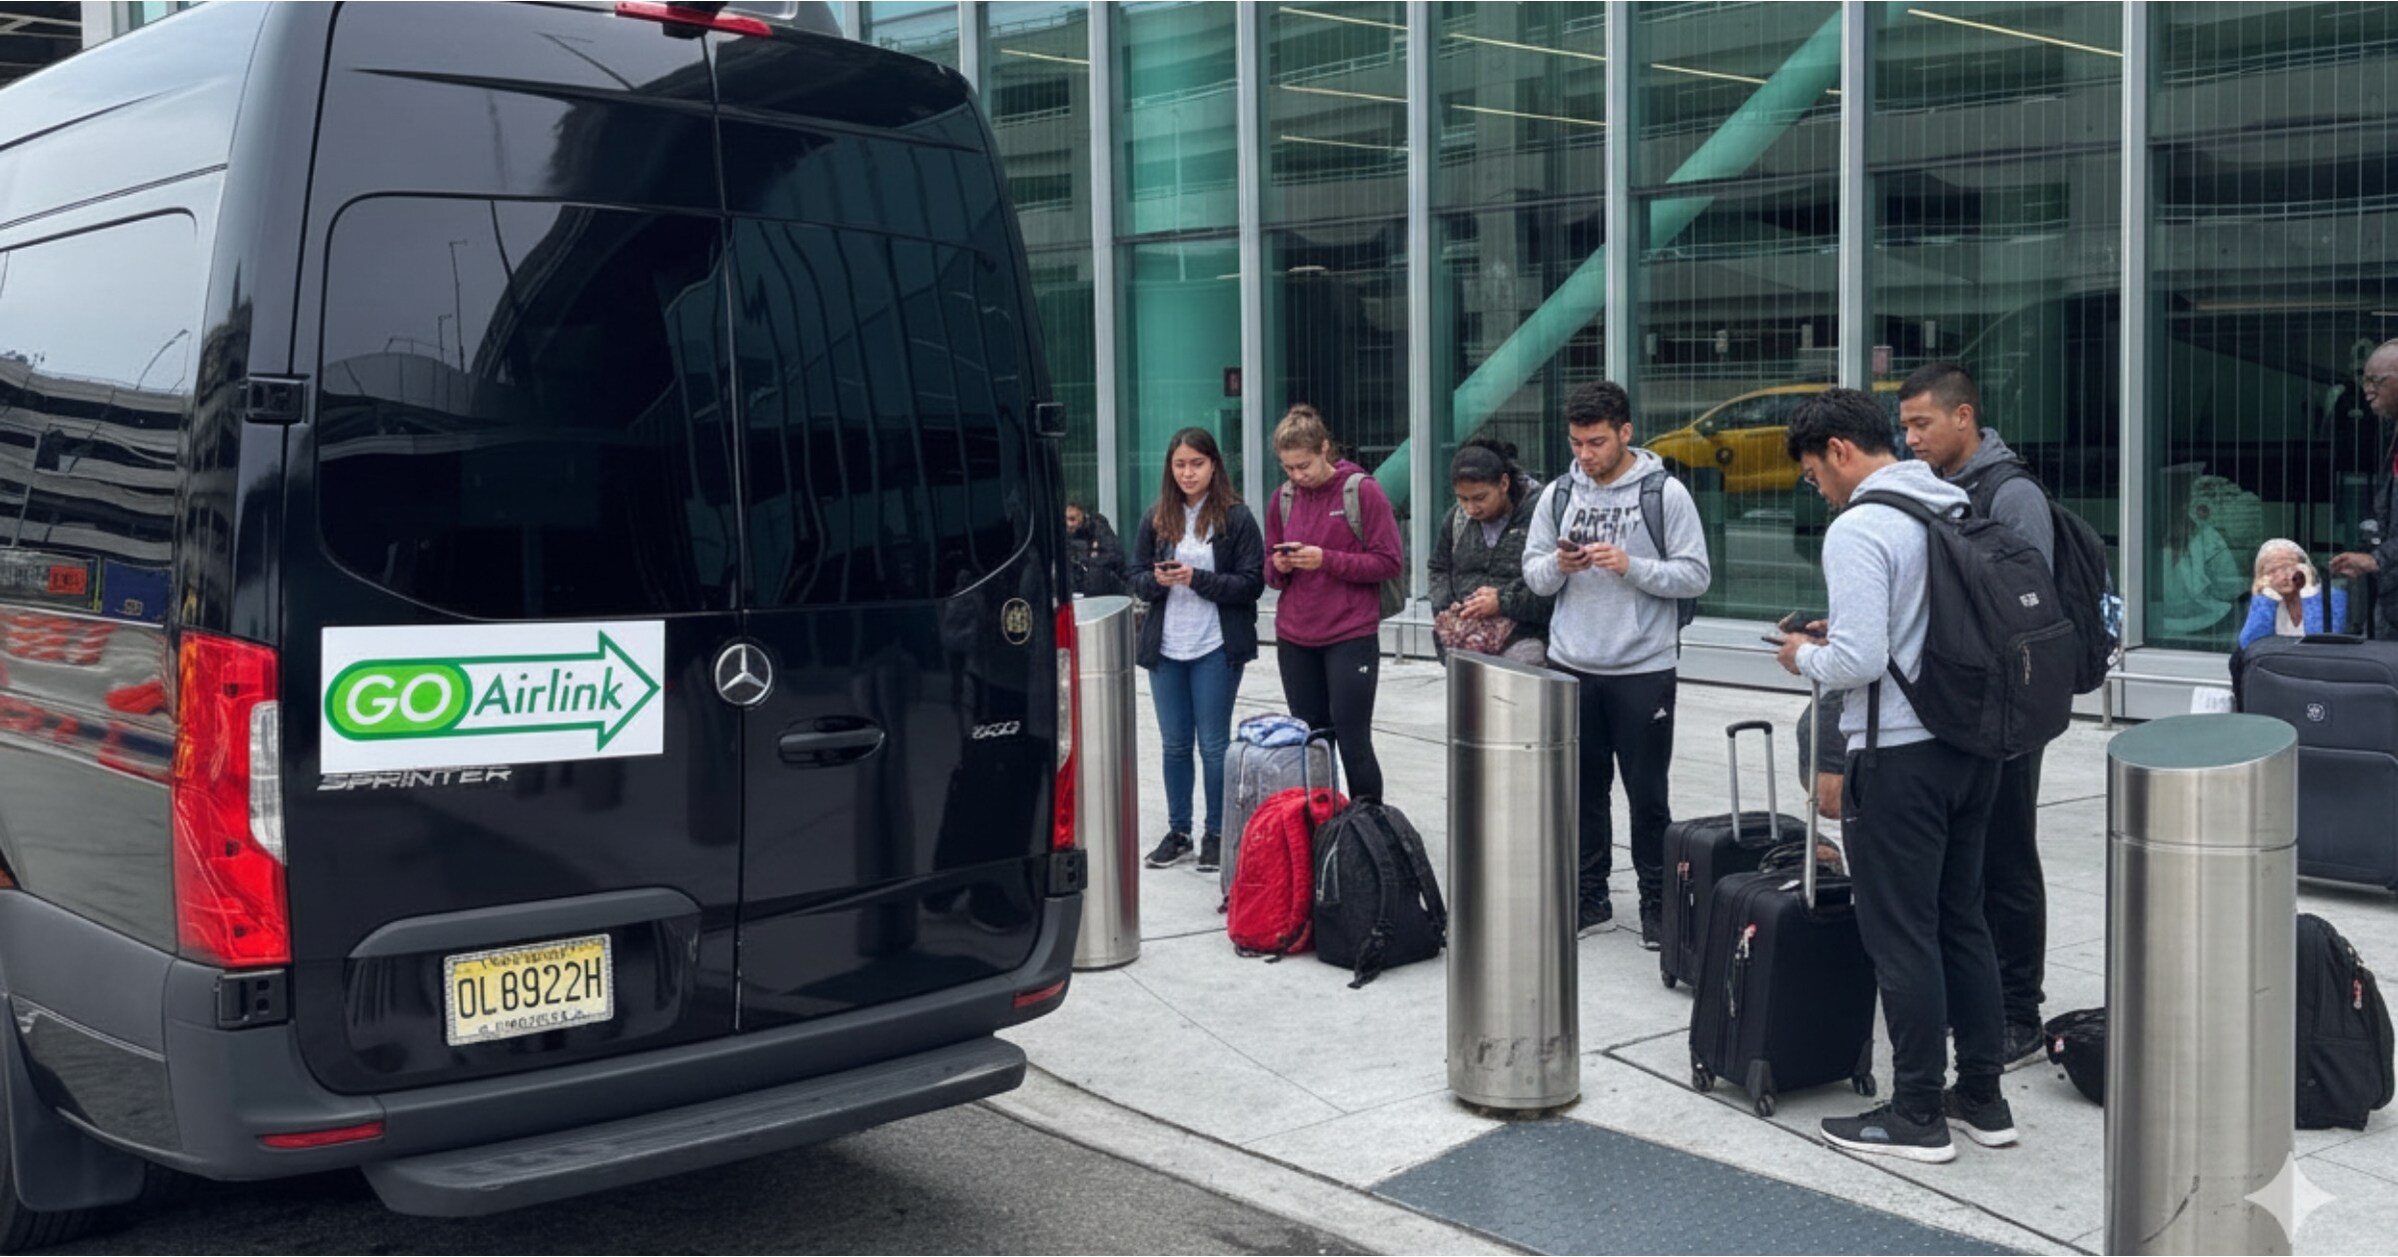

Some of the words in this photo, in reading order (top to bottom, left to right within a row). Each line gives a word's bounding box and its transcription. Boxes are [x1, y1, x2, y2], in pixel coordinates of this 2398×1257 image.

[346, 673, 452, 726] GO
[473, 666, 623, 716] Airlink
[317, 766, 512, 791] SPRINTER
